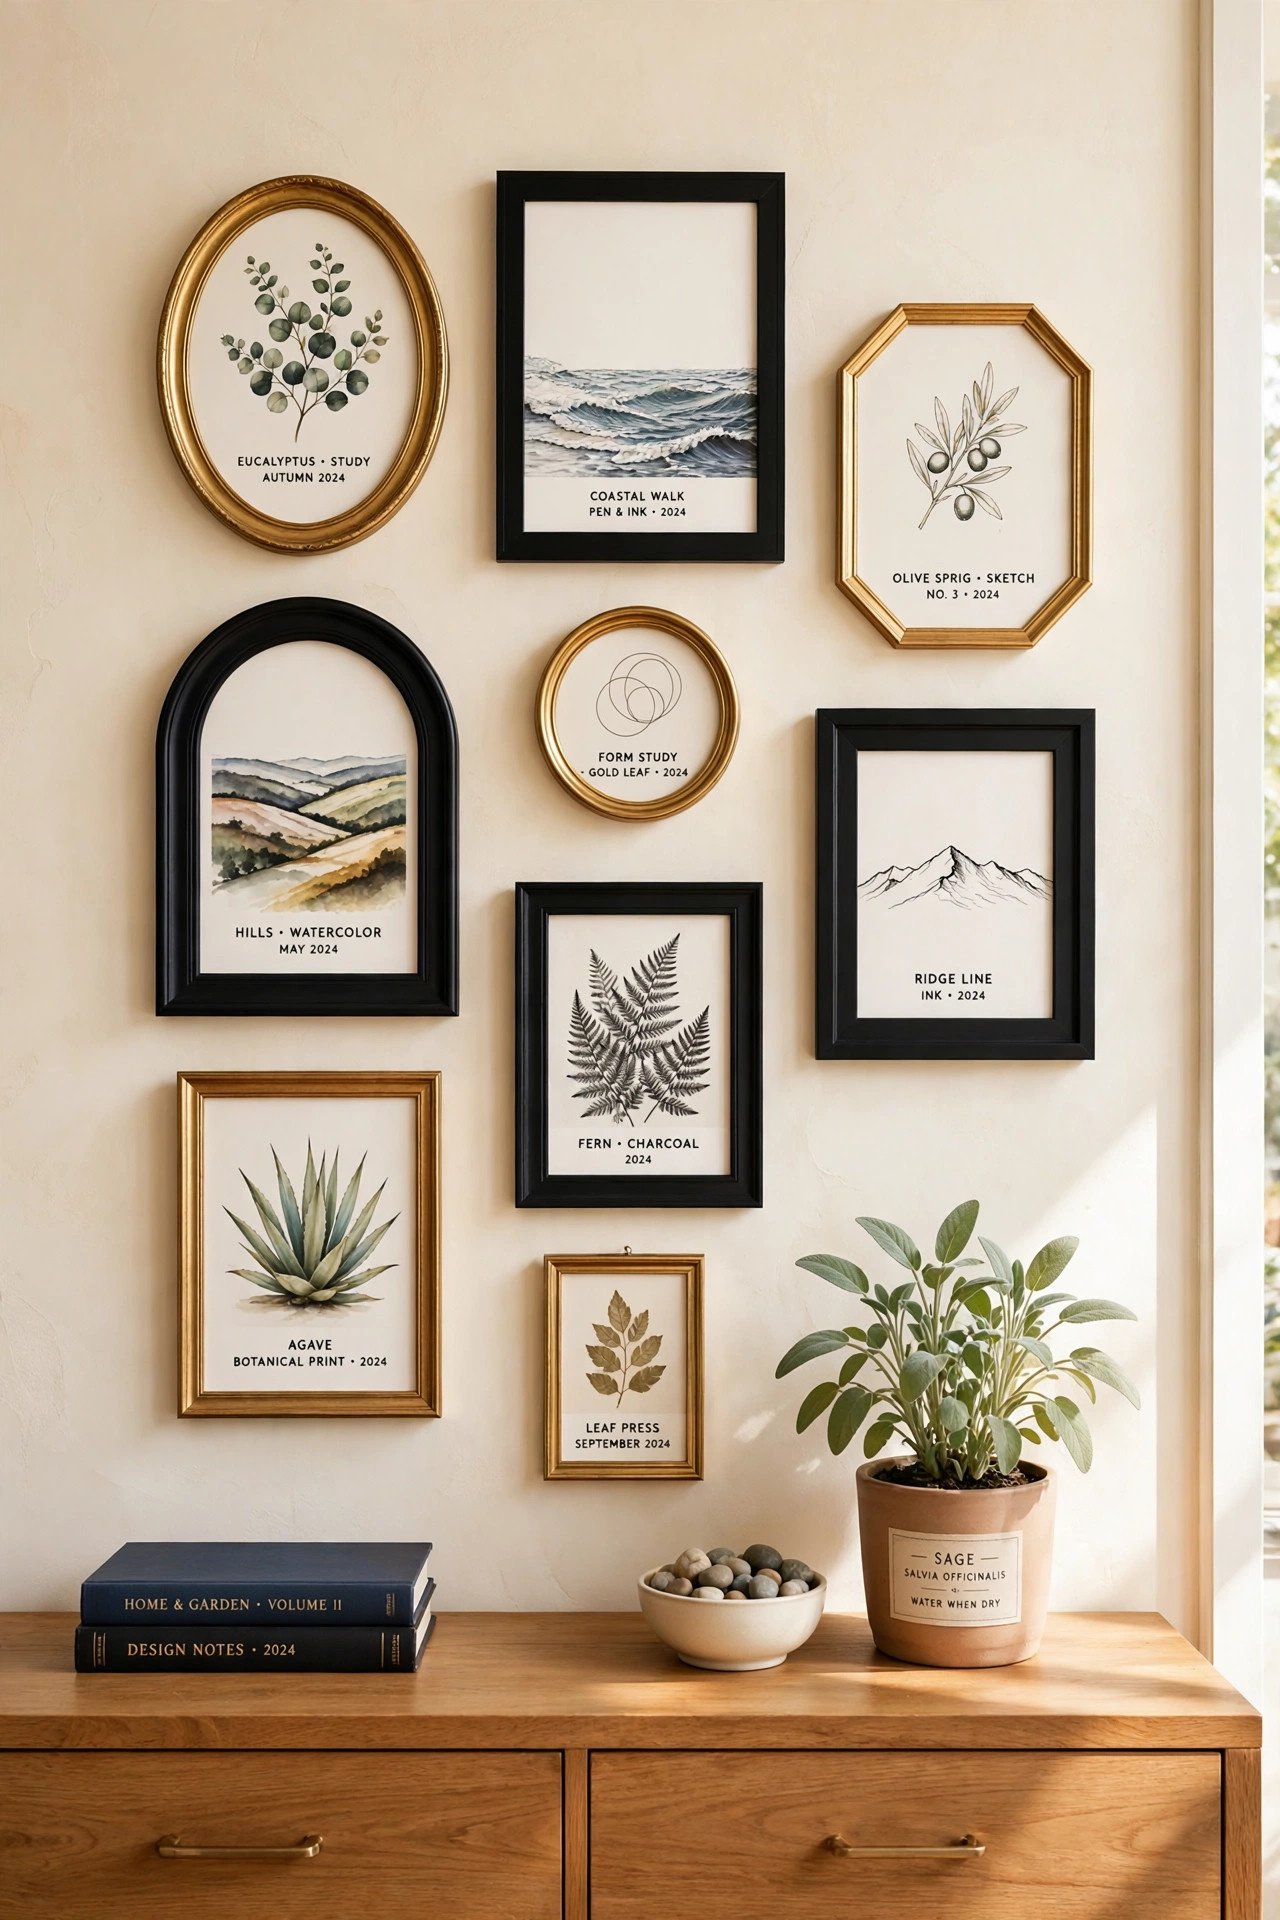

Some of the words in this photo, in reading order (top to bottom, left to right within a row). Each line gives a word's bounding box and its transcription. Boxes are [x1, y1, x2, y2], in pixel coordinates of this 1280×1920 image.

[237, 456, 316, 467] EUCALYPTUS
[330, 456, 371, 467] STUDY
[262, 472, 314, 483] AUTUMN
[318, 472, 346, 483] 2024
[589, 490, 646, 502] COASTAL
[650, 491, 685, 502] WALK
[589, 506, 612, 517] PEN
[615, 506, 623, 517] &
[627, 506, 648, 517] INK
[660, 507, 687, 517] 2024
[892, 572, 930, 584] OLIVE
[934, 572, 971, 584] SPRIG
[986, 572, 1035, 584] SKETCH
[972, 589, 1000, 600] 2024
[598, 751, 634, 763] FORM
[638, 751, 678, 763] STUDY
[588, 767, 620, 778] GOLD
[623, 767, 651, 778] LEAF
[662, 767, 689, 778] 2024
[235, 926, 274, 939] HILLS
[289, 926, 382, 938] WATERCOLOR
[279, 943, 306, 955] MAY
[309, 944, 339, 955] 2024
[914, 973, 956, 985] RIDGE
[961, 973, 993, 985] LINE
[921, 989, 943, 1001] INK
[957, 990, 986, 1001] 2024
[578, 1138, 612, 1150] FERN
[627, 1138, 700, 1149] CHARCOAL
[624, 1154, 652, 1165] 2024
[287, 1339, 333, 1351] AGAVE
[233, 1356, 304, 1367] BOTANICAL
[308, 1356, 346, 1367] PRINT
[359, 1356, 388, 1367] 2024
[586, 1422, 617, 1434] LEAF
[621, 1422, 660, 1434] PRESS
[575, 1438, 641, 1449] SEPTEMBER
[644, 1438, 671, 1449] 2024
[934, 1551, 975, 1566] SAGE
[903, 1567, 939, 1581] SALVIA
[942, 1570, 1006, 1582] OFFICINALIS
[124, 1598, 168, 1611] HOME
[173, 1598, 184, 1611] &
[188, 1598, 250, 1611] GARDEN
[267, 1598, 328, 1611] VOLUME
[333, 1599, 342, 1611] II
[910, 1595, 943, 1609] WATER
[946, 1599, 977, 1609] WHEN
[981, 1598, 1001, 1609] DRY
[127, 1643, 186, 1657] DESIGN
[192, 1643, 244, 1657] NOTES
[263, 1643, 296, 1656] 2024
